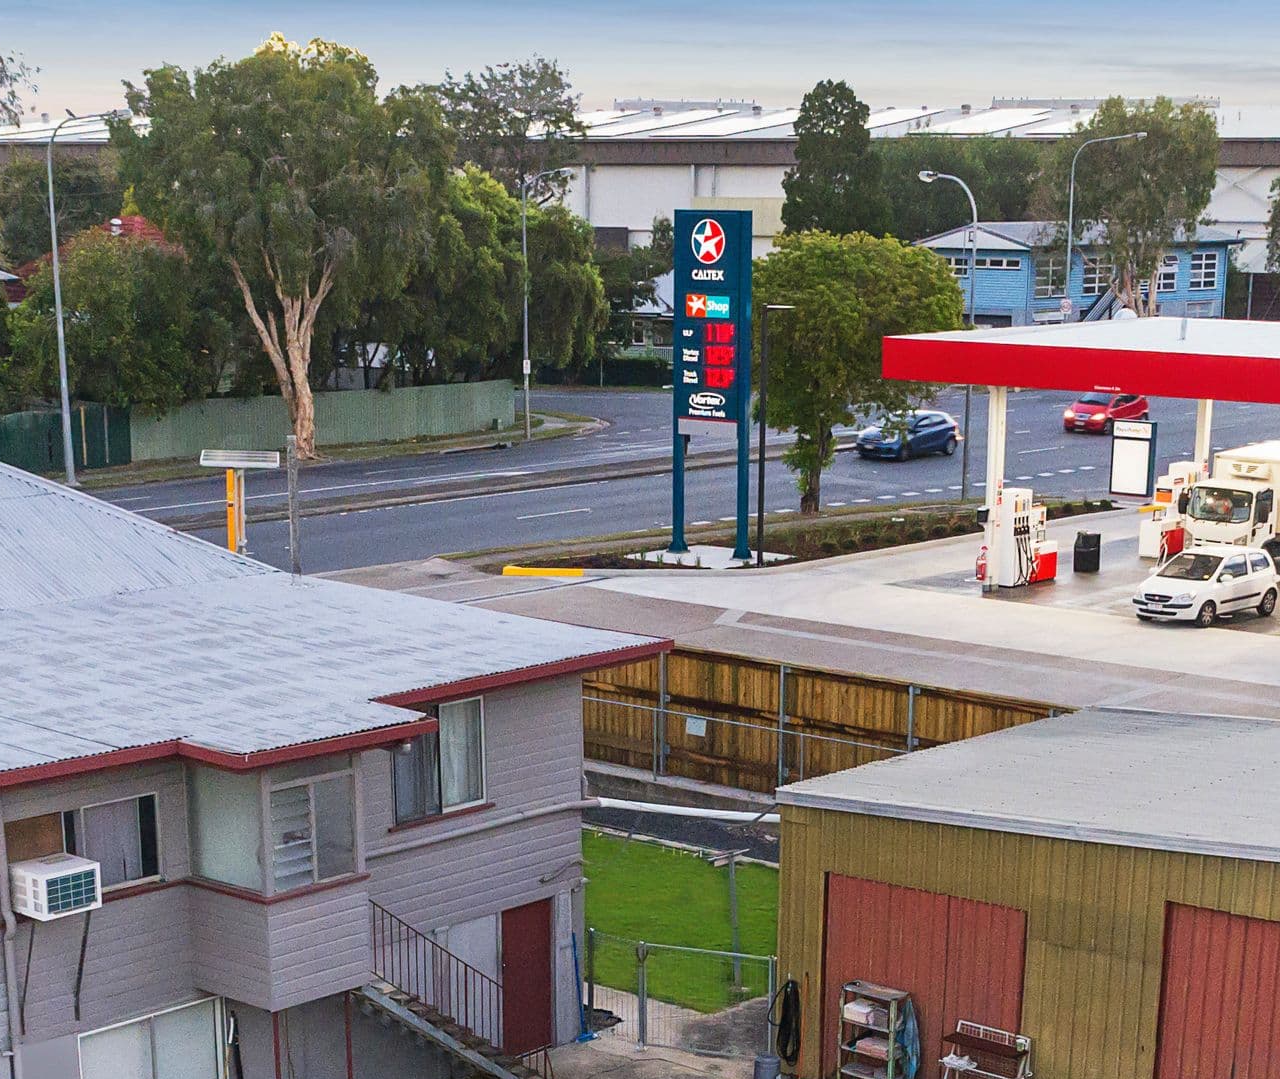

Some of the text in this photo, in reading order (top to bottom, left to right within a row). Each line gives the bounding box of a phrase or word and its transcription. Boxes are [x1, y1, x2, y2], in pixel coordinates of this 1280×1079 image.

[691, 269, 725, 281] CALTEX
[707, 300, 729, 314] Shop
[691, 393, 722, 406] Vortex
